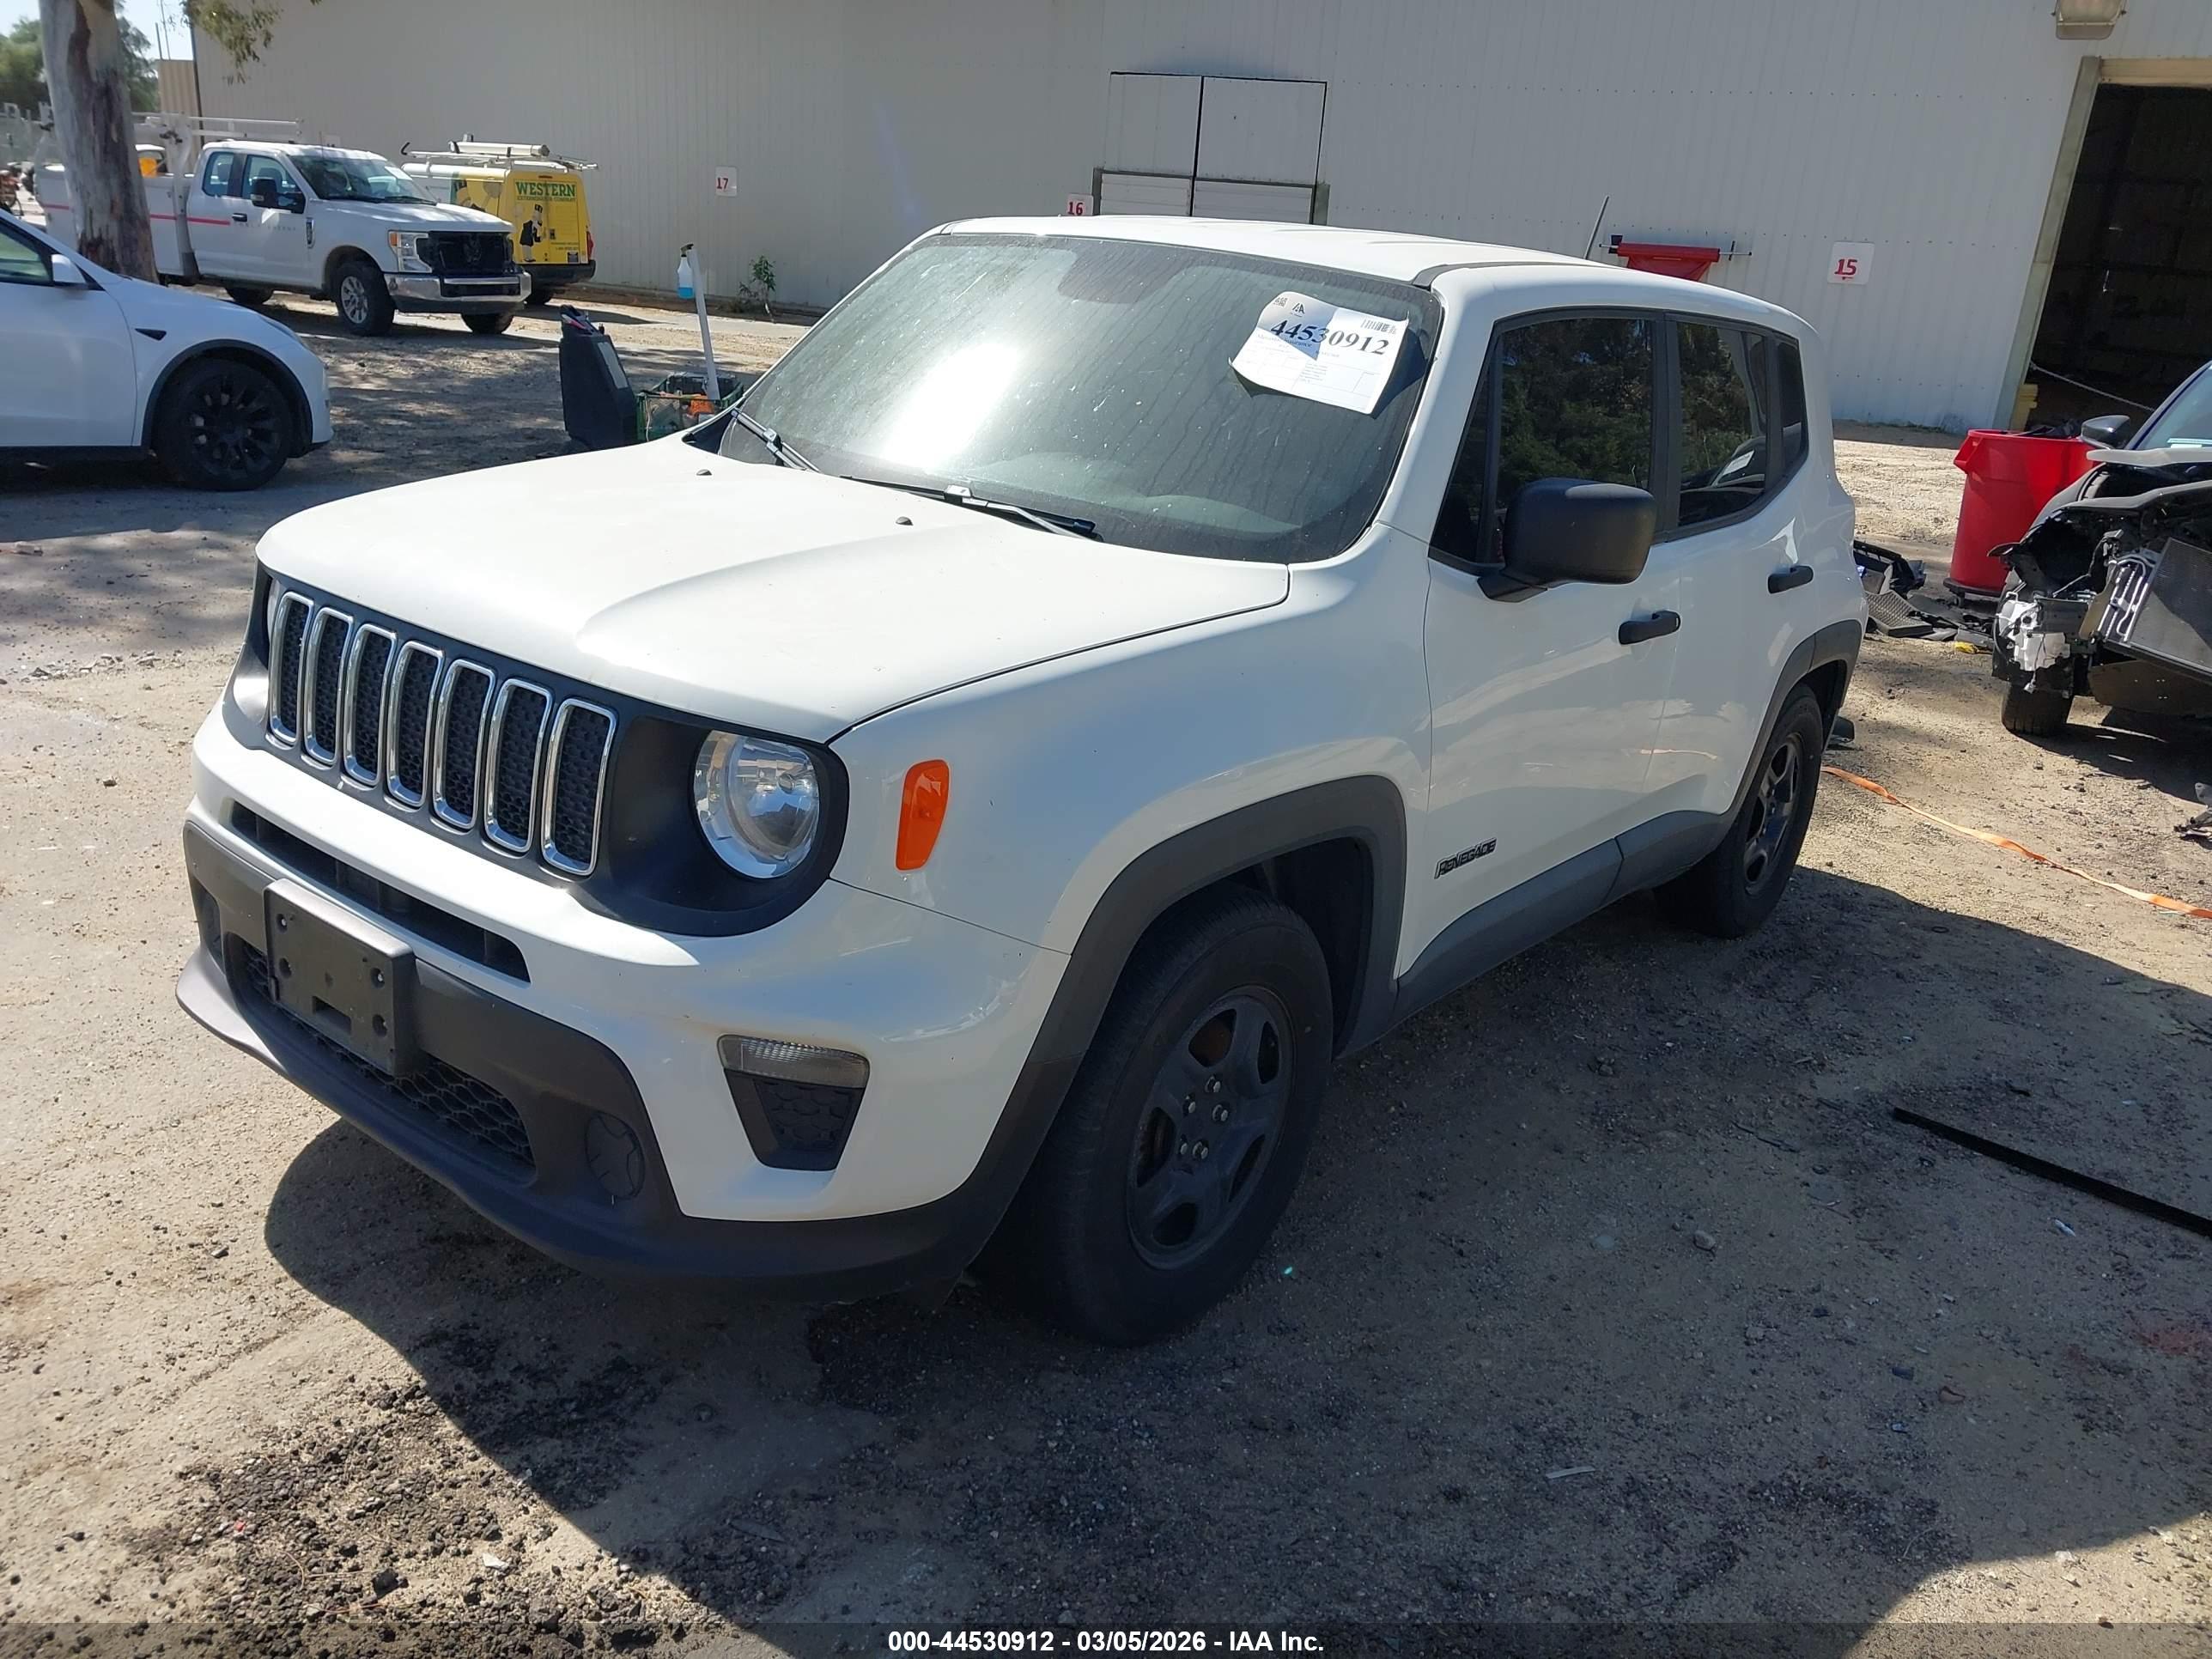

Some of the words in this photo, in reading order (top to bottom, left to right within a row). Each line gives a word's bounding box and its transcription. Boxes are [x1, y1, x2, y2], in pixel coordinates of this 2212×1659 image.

[515, 181, 576, 198] WESTERN
[716, 177, 729, 191] 17
[1067, 201, 1084, 216] 16
[1834, 258, 1858, 276] 15
[1270, 319, 1390, 356] 44530912
[1434, 837, 1498, 879] RENEGADE
